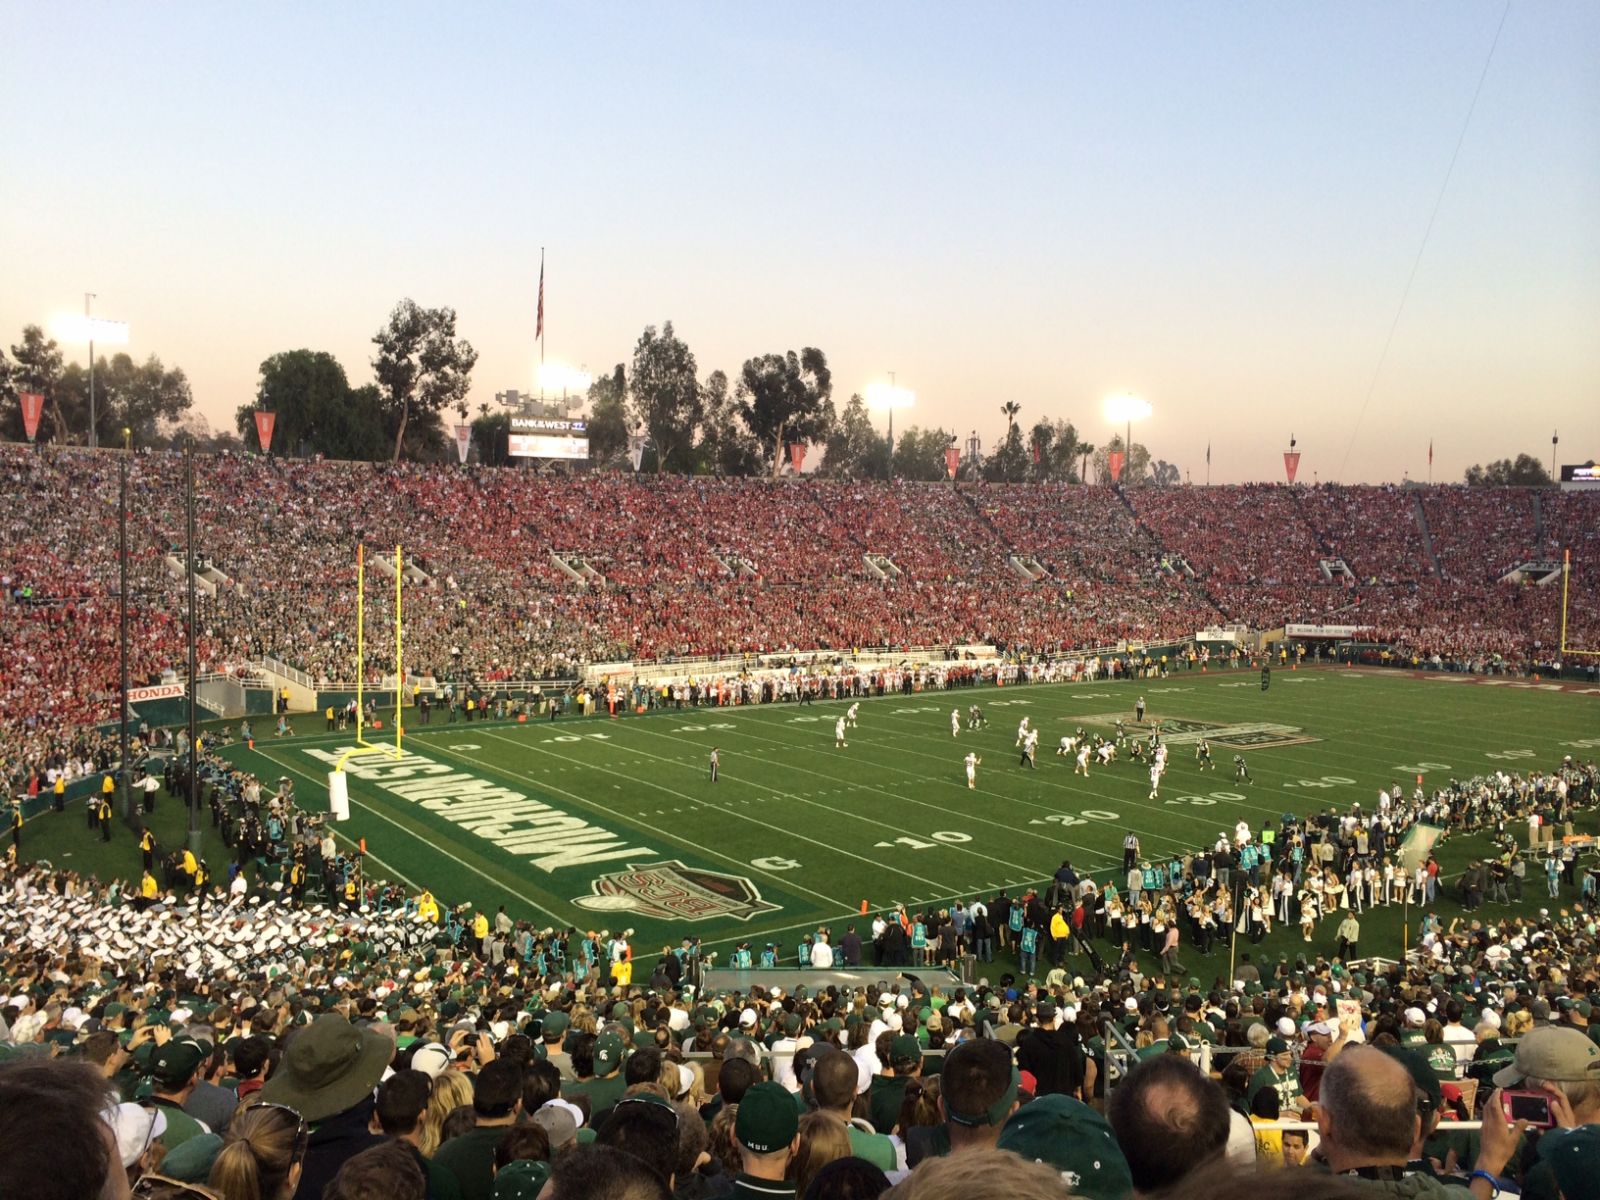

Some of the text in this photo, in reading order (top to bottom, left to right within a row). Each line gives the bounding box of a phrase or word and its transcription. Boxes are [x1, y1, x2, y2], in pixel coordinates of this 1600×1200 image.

[127, 685, 183, 700] HONDA
[1297, 776, 1357, 788] 40
[1176, 792, 1247, 806] 30
[374, 773, 661, 874] MICHIGAN
[1045, 810, 1120, 826] 20
[894, 831, 973, 849] 10
[750, 856, 803, 870] G
